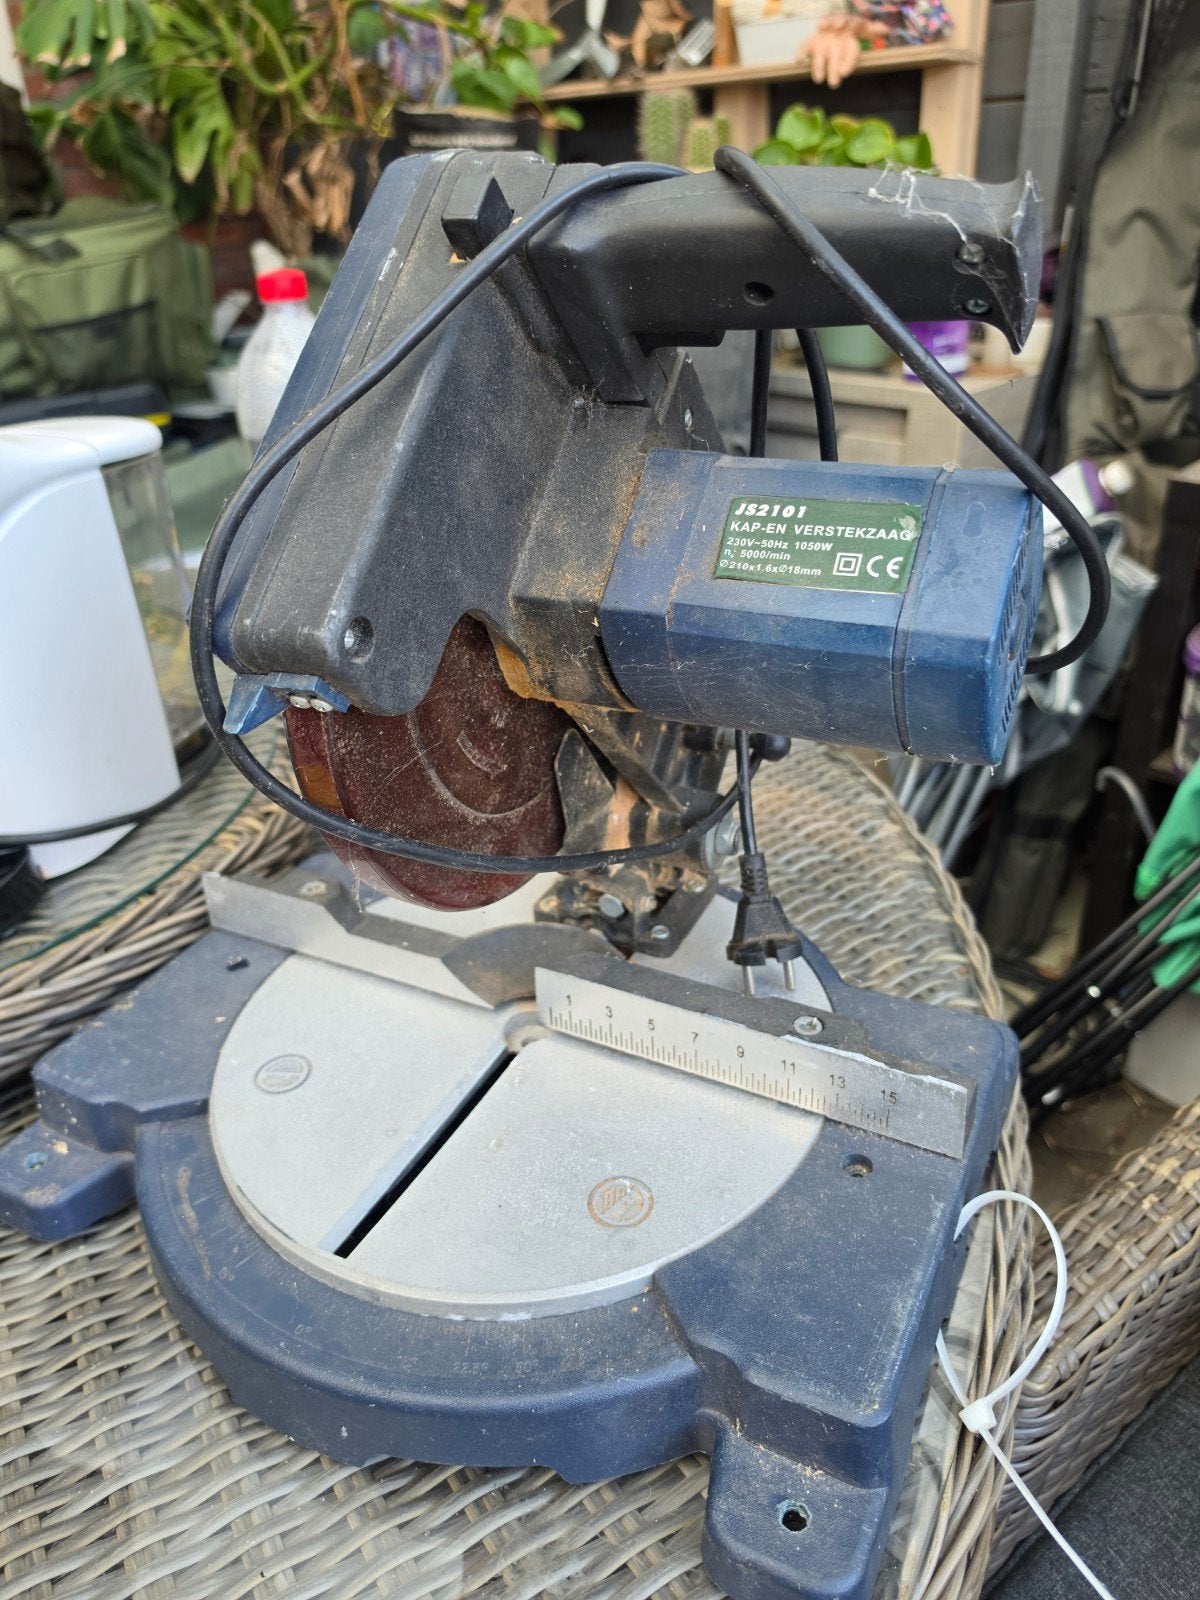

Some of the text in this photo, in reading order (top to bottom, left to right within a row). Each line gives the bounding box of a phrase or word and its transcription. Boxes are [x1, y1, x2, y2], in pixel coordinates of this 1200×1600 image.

[734, 503, 807, 518] JS2101
[730, 521, 912, 541] KAP-EN VERSTEKZAAG
[727, 537, 833, 551] 230V~50Hz 1050W
[740, 549, 791, 560] 5000/min
[866, 555, 904, 579] CE
[566, 994, 897, 1104] 1 3 5 7 9 11 13 15
